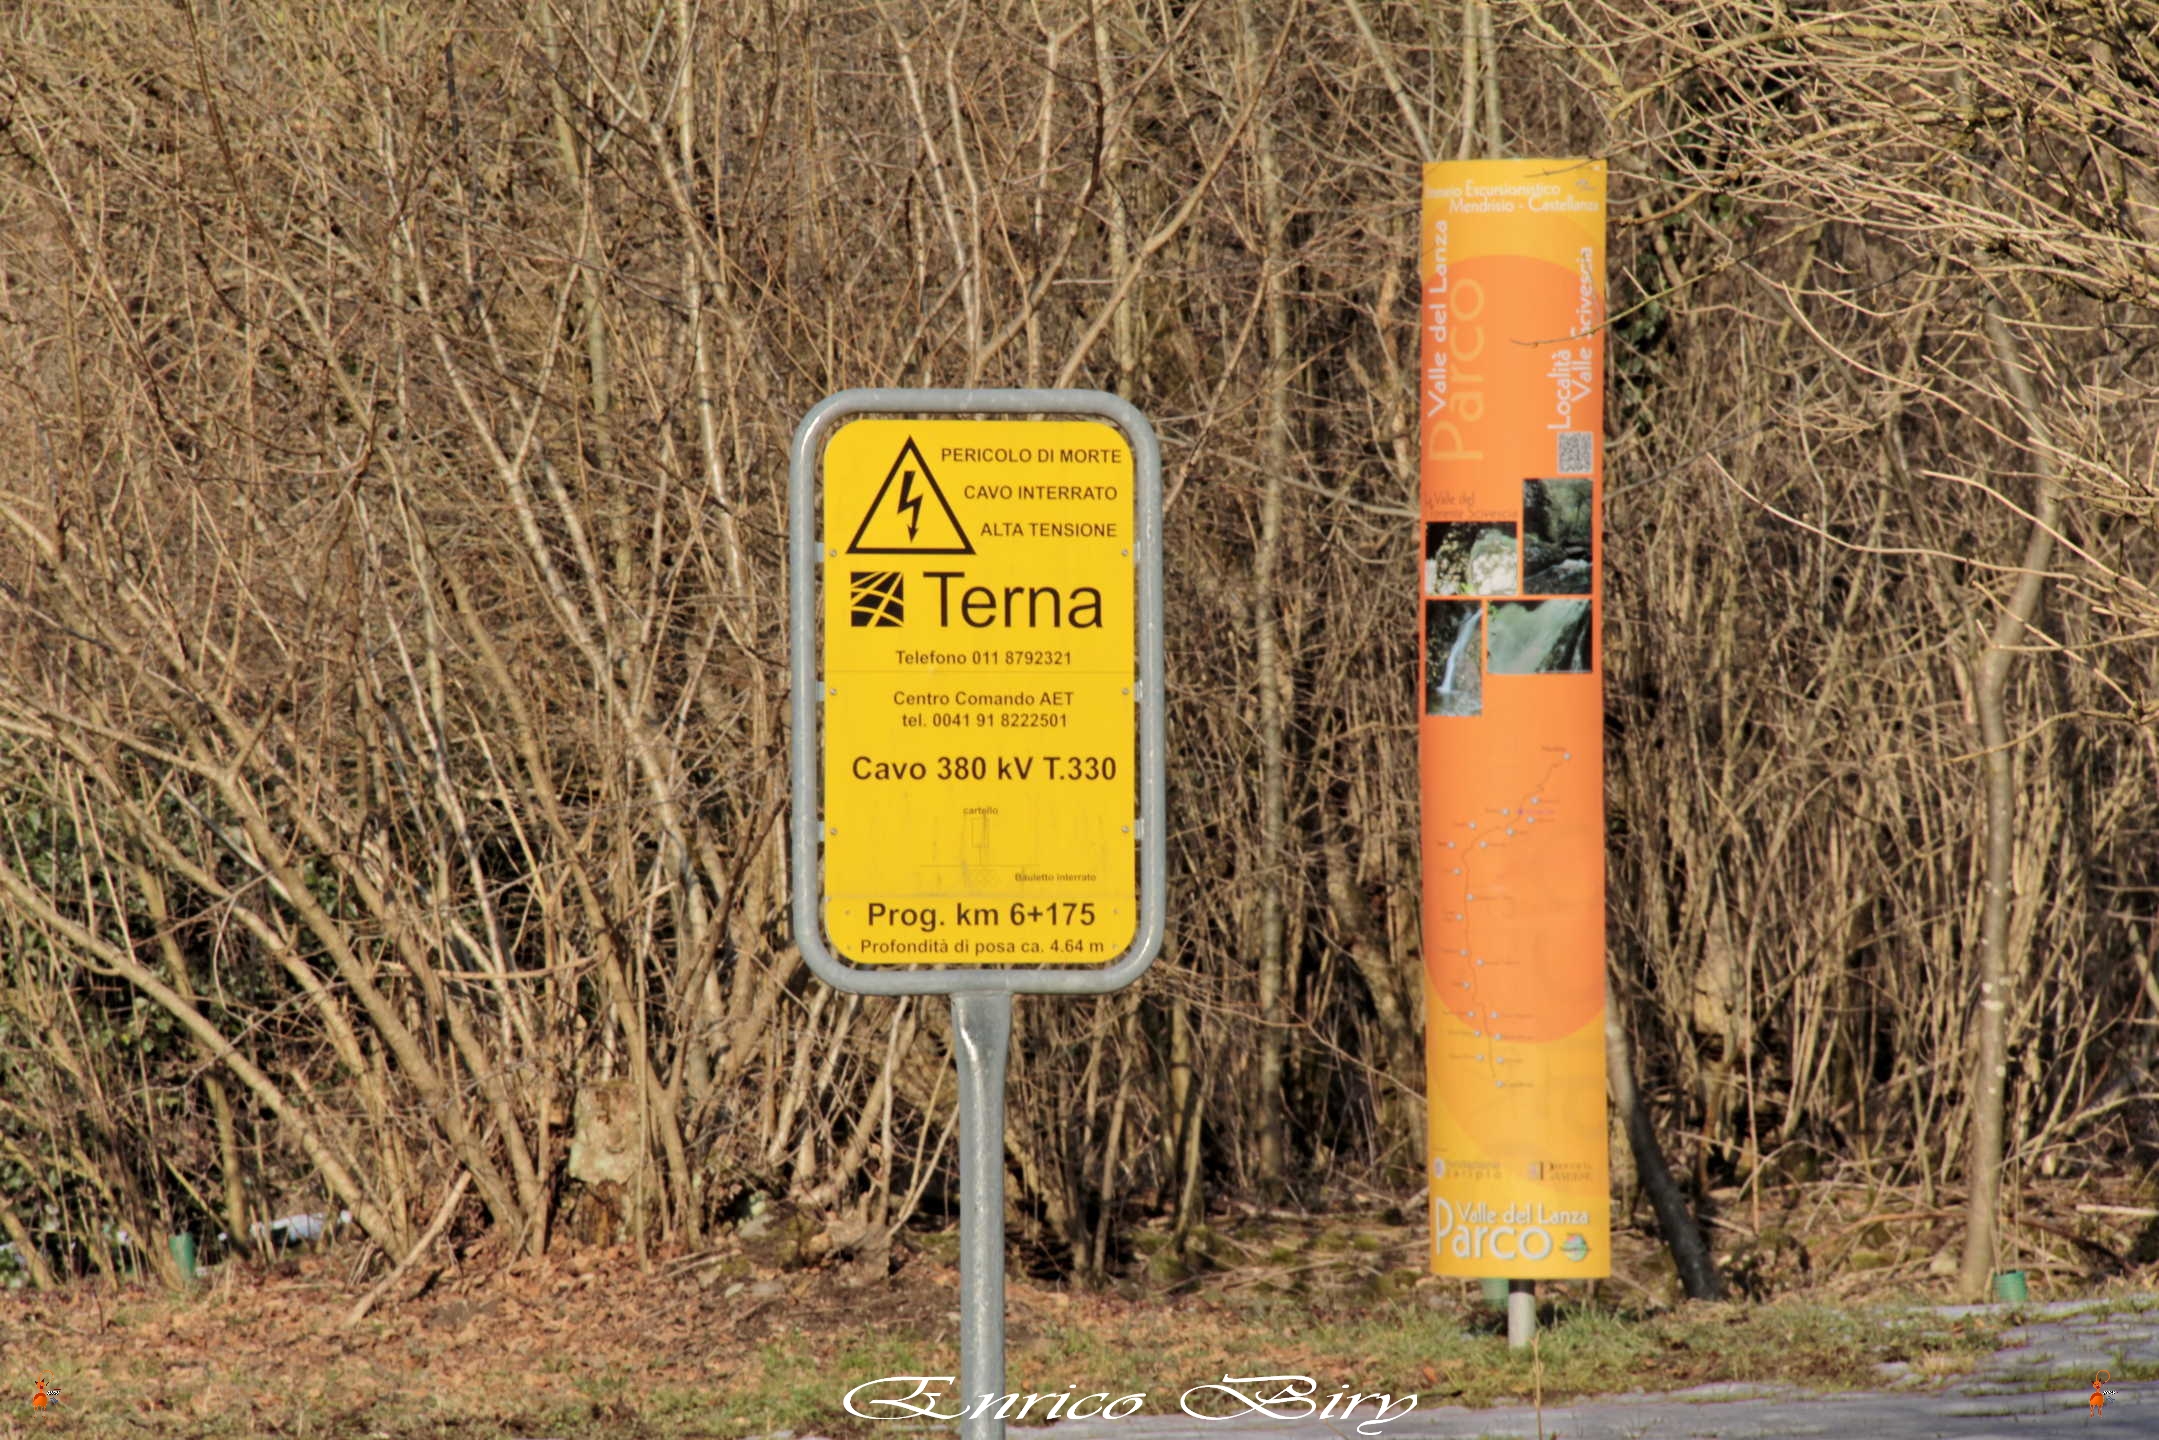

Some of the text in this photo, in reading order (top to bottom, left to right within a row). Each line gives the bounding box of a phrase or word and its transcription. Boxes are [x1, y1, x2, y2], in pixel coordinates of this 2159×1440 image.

[1449, 197, 1515, 213] Mendrisio
[1429, 220, 1448, 294] Lanza
[1428, 302, 1448, 343] del
[1428, 278, 1485, 462] Parco
[1571, 347, 1593, 402] Valle
[1428, 350, 1448, 417] Valle
[1546, 348, 1572, 430] Località
[941, 447, 1121, 464] PERICOLO DI MORTE
[963, 484, 1118, 501] CAVO INTERRATO
[980, 522, 1116, 538] ALTA TENSIONE
[922, 571, 1103, 629] Terna
[895, 650, 1071, 665] Telefono 011 8792321
[893, 690, 1073, 706] Centro Comando AET
[901, 712, 1067, 728] tel. 0041 91 8222501
[852, 755, 1117, 781] Cavo 380 kV T.330
[963, 806, 999, 817] cartello
[868, 902, 1096, 933] Prog. km 6+175
[860, 938, 1105, 957] Profondità di posa ca. 4.64 m
[1456, 1201, 1589, 1225] Valle del Lanza
[1435, 1197, 1553, 1260] Parco
